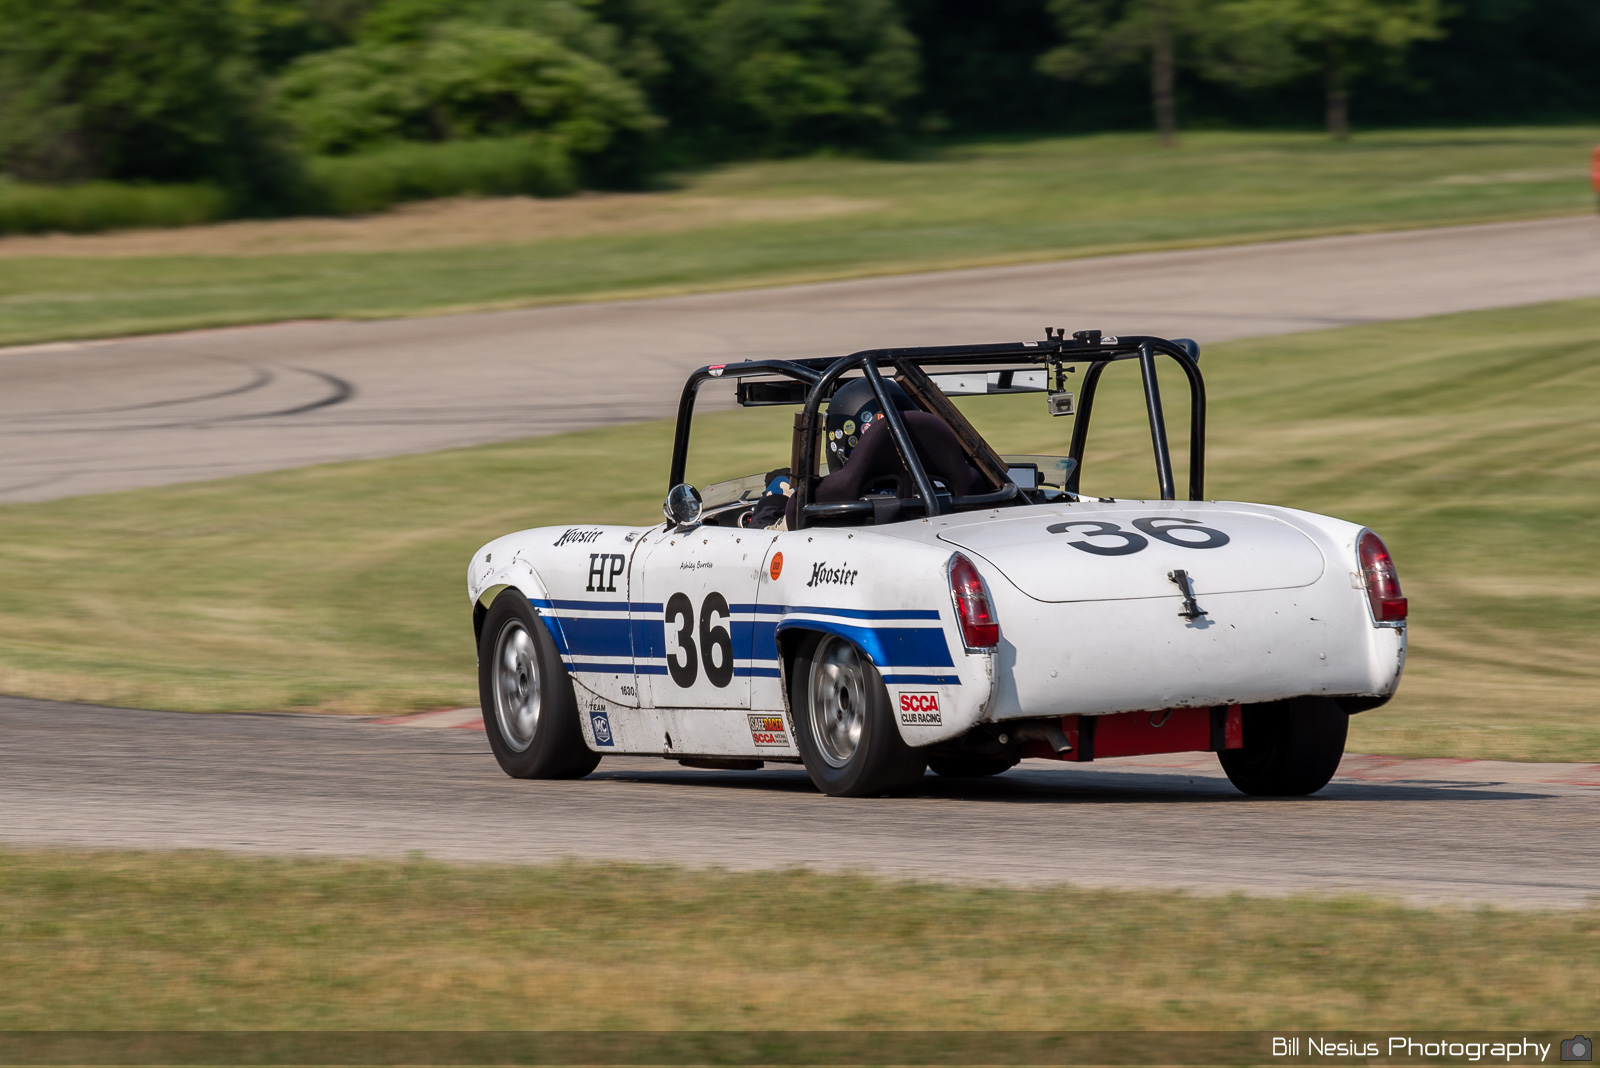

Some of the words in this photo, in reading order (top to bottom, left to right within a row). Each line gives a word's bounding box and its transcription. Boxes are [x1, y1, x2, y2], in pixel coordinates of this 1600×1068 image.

[553, 527, 603, 547] Hoosier
[1046, 517, 1230, 556] 36
[586, 553, 625, 592] HP
[806, 561, 859, 588] Hoosier
[665, 591, 734, 689] 36
[620, 685, 635, 696] 1630
[589, 703, 606, 711] TEAM
[901, 695, 939, 712] SCCA
[902, 713, 917, 723] CLUB
[918, 713, 941, 723] RACING
[753, 733, 776, 744] SCCA
